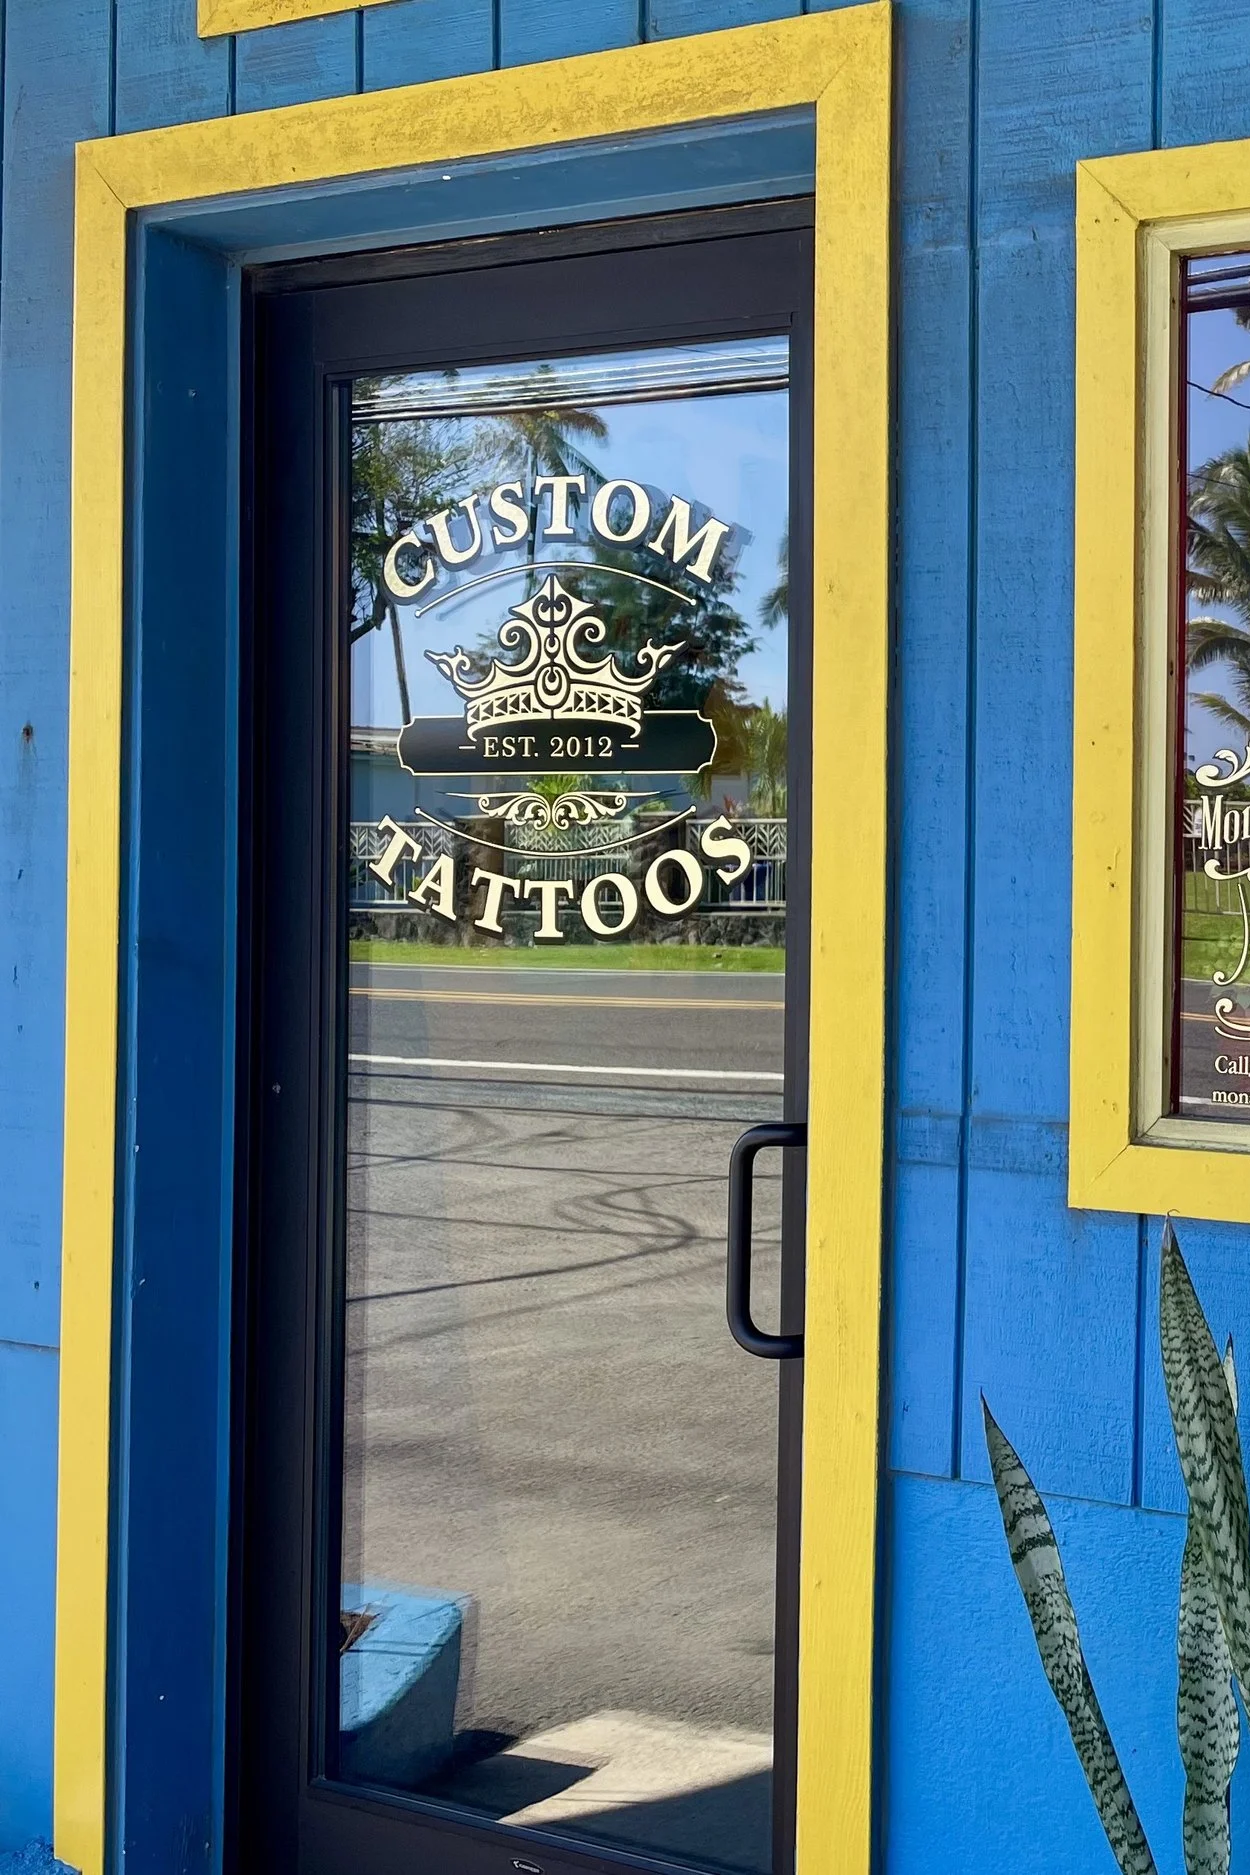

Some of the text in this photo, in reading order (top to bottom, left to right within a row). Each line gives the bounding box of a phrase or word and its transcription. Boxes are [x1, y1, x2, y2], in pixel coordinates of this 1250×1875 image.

[382, 474, 730, 599] CUSTOM
[483, 736, 614, 759] EST. 2012
[368, 814, 752, 939] TATTOOS
